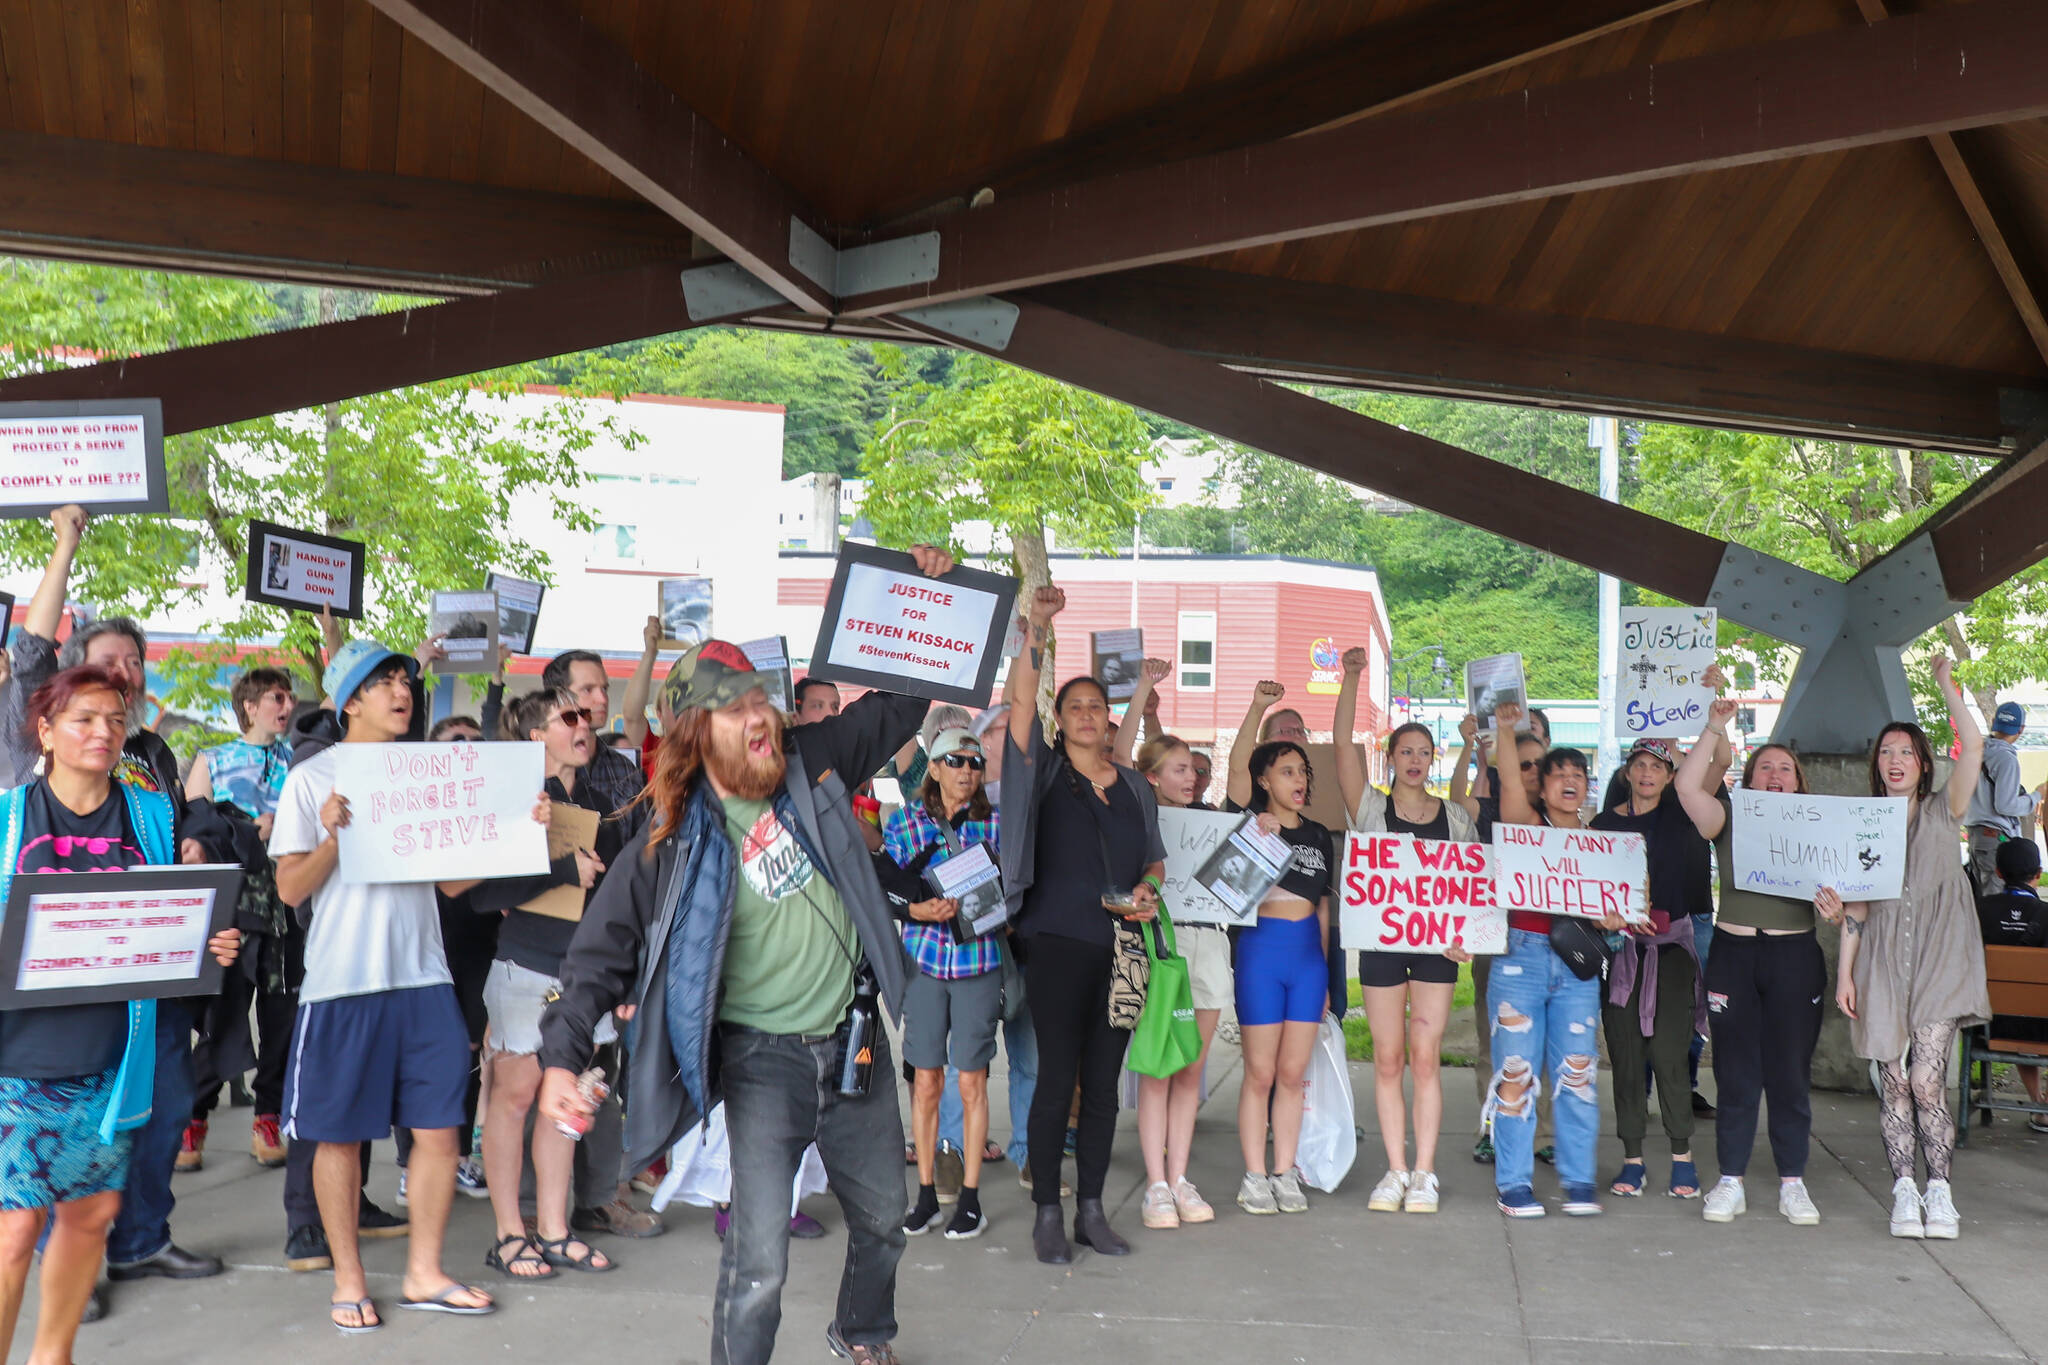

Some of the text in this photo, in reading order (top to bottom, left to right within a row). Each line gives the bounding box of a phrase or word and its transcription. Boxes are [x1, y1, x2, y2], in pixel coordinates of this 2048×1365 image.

[37, 425, 58, 435] DID
[62, 425, 80, 434] WE
[84, 424, 101, 434] GO
[104, 423, 138, 433] FROM
[13, 440, 126, 452] PROTECT & SERVE
[62, 457, 79, 466] TO
[1, 472, 140, 488] COMPLY or DIE ???
[296, 551, 346, 568] HANDS UP
[306, 568, 335, 581] GUNS
[305, 582, 335, 596] DOWN
[887, 582, 953, 606] JUSTICE
[902, 608, 927, 622] FOR
[845, 618, 975, 654] STEVEN KISSACK
[858, 643, 951, 670] #StevenKissack
[1626, 698, 1703, 732] Steve
[370, 776, 485, 825] FORGET
[1743, 795, 1823, 821] HE WAS
[1870, 806, 1895, 817] LOVE
[391, 812, 499, 857] STEVE
[1502, 826, 1545, 847] HOW
[1564, 833, 1617, 854] MANY
[1349, 837, 1401, 869] HE
[1413, 841, 1486, 874] WAS
[1541, 855, 1583, 876] WILL
[1768, 833, 1849, 877] HUMAN
[1508, 872, 1630, 917] SUFFER?
[1379, 906, 1467, 947] SON!
[25, 956, 104, 970] COMPLY
[132, 952, 161, 964] DIE
